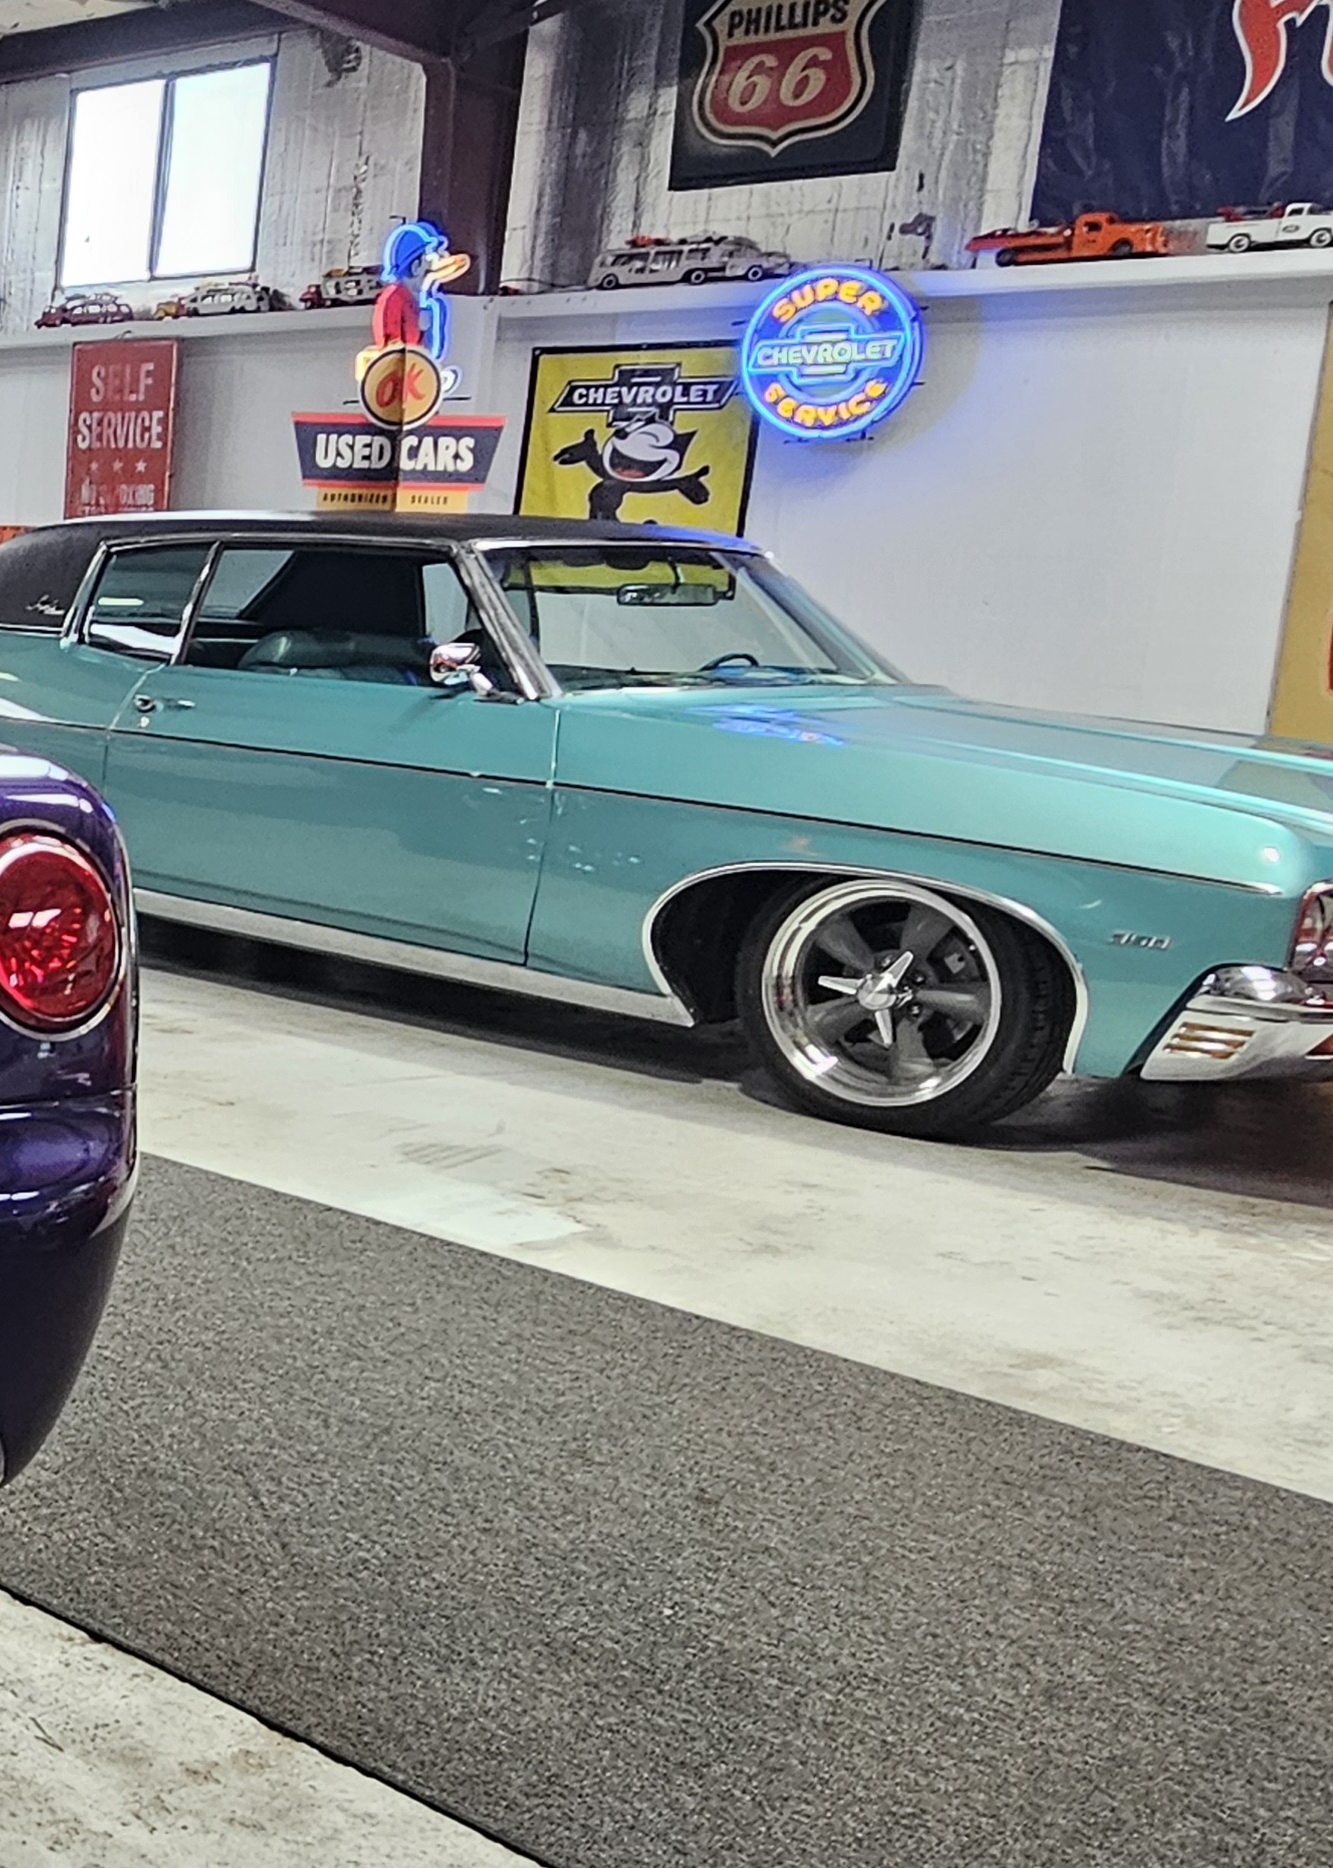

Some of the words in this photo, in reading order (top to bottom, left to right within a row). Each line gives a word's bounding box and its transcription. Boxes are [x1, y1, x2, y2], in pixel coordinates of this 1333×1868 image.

[727, 0, 849, 38] PHILLIPS
[727, 46, 833, 113] 66
[772, 277, 885, 323] SUPER
[757, 339, 898, 367] CHEVROLET
[90, 362, 155, 402] SELF
[376, 363, 426, 408] OK
[572, 383, 720, 405] CHEVROLET
[764, 379, 888, 428] SERVICE
[77, 410, 164, 450] SERVICE
[315, 433, 392, 470] USED
[398, 437, 475, 472] CARS
